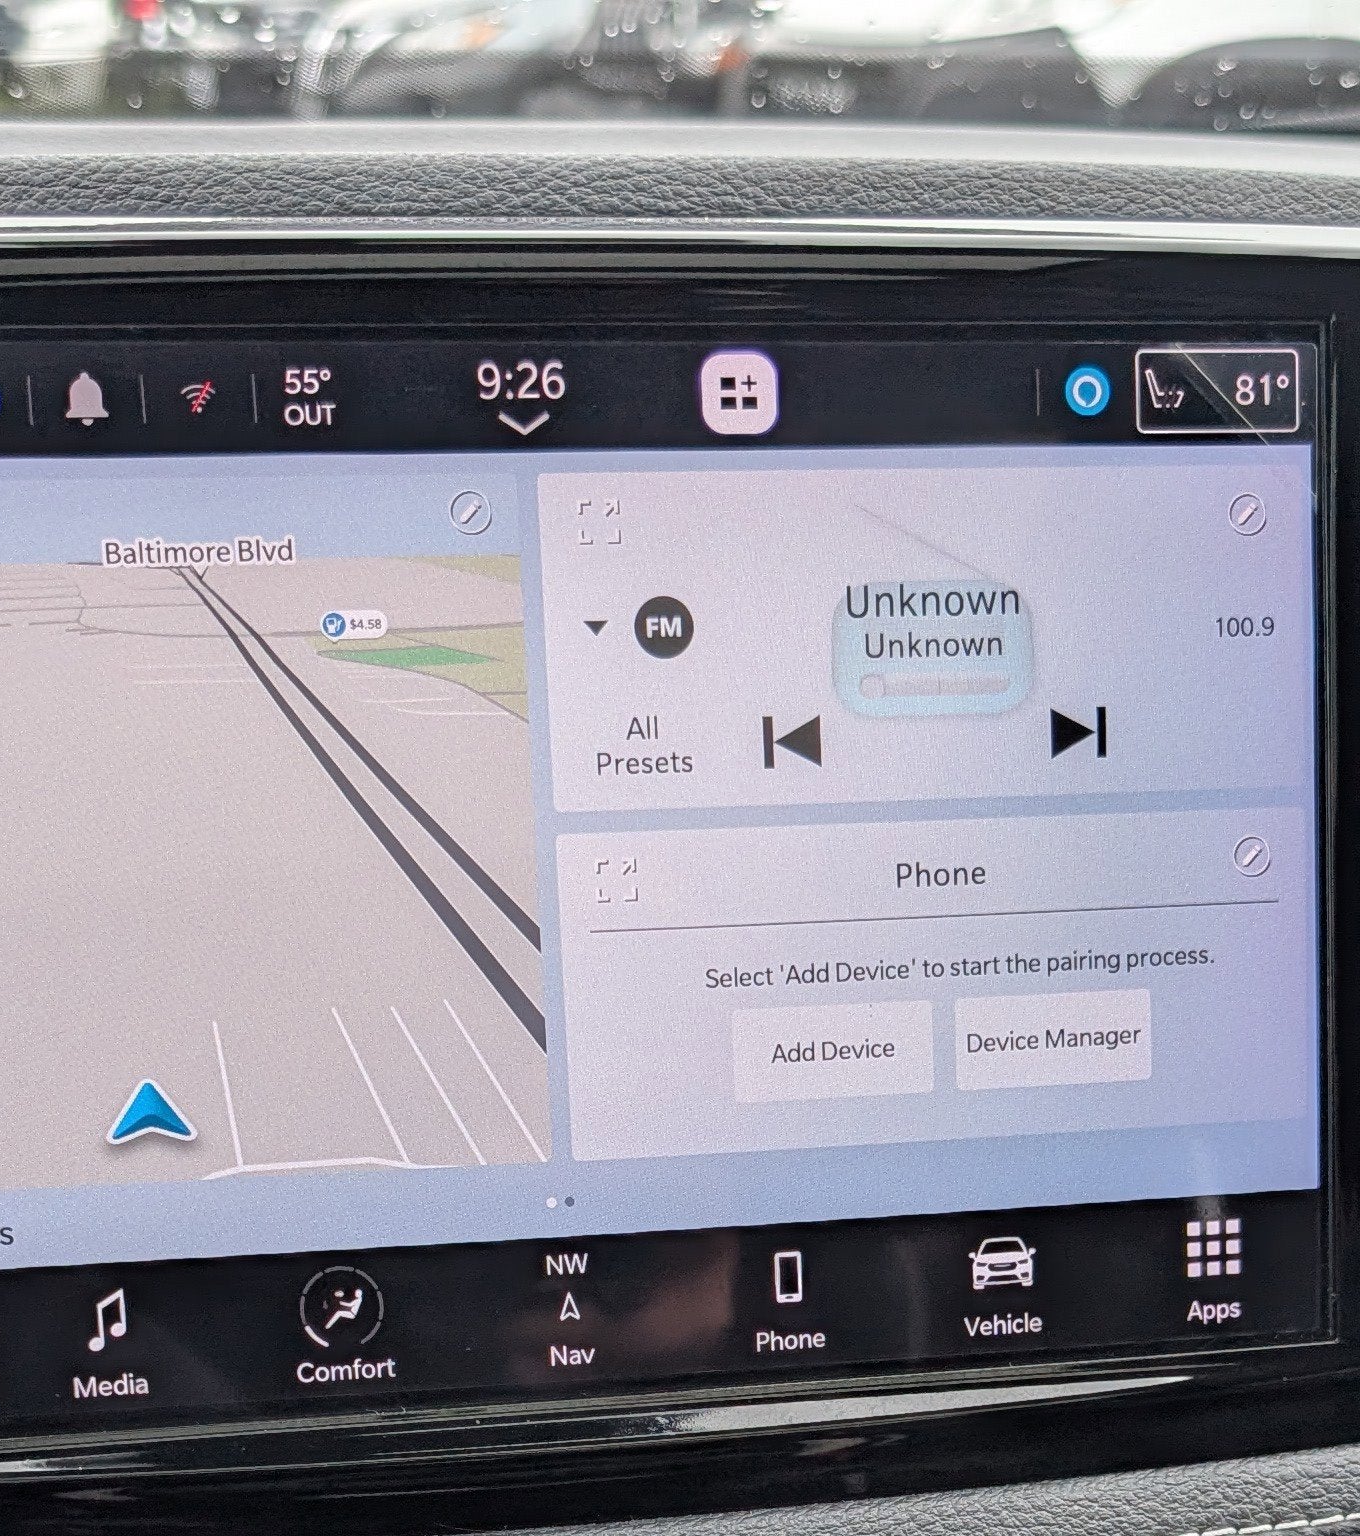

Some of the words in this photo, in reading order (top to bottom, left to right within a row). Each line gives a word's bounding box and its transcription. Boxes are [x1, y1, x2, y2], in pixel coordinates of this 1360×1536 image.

[284, 368, 332, 395] 55°
[476, 362, 566, 400] 9:26
[1234, 375, 1290, 406] 81°
[284, 403, 336, 427] OUT
[103, 540, 230, 566] Baltimore
[237, 538, 295, 563] Blvd
[845, 585, 1021, 619] Unknown
[349, 617, 383, 632] $4.58
[645, 615, 683, 639] FM
[1215, 616, 1275, 638] 100.9
[863, 631, 1004, 660] Unknown
[626, 717, 659, 741] All
[595, 749, 694, 777] Presets
[895, 861, 987, 889] Phone
[705, 965, 774, 988] Select
[922, 959, 945, 978] to
[950, 954, 1000, 977] start
[1005, 952, 1041, 975] the
[1046, 948, 1121, 977] pairing
[1126, 944, 1215, 972] process.
[771, 1040, 816, 1063] Add
[821, 1037, 895, 1061] Device
[966, 1029, 1039, 1054] Device
[1045, 1023, 1141, 1054] Manager
[544, 1252, 589, 1276] NW
[964, 1312, 1043, 1336] Vehicle
[1186, 1298, 1242, 1324] Apps
[755, 1327, 826, 1352] Phone
[550, 1343, 596, 1366] Nav
[296, 1357, 397, 1385] Comfort
[72, 1373, 149, 1399] Media
